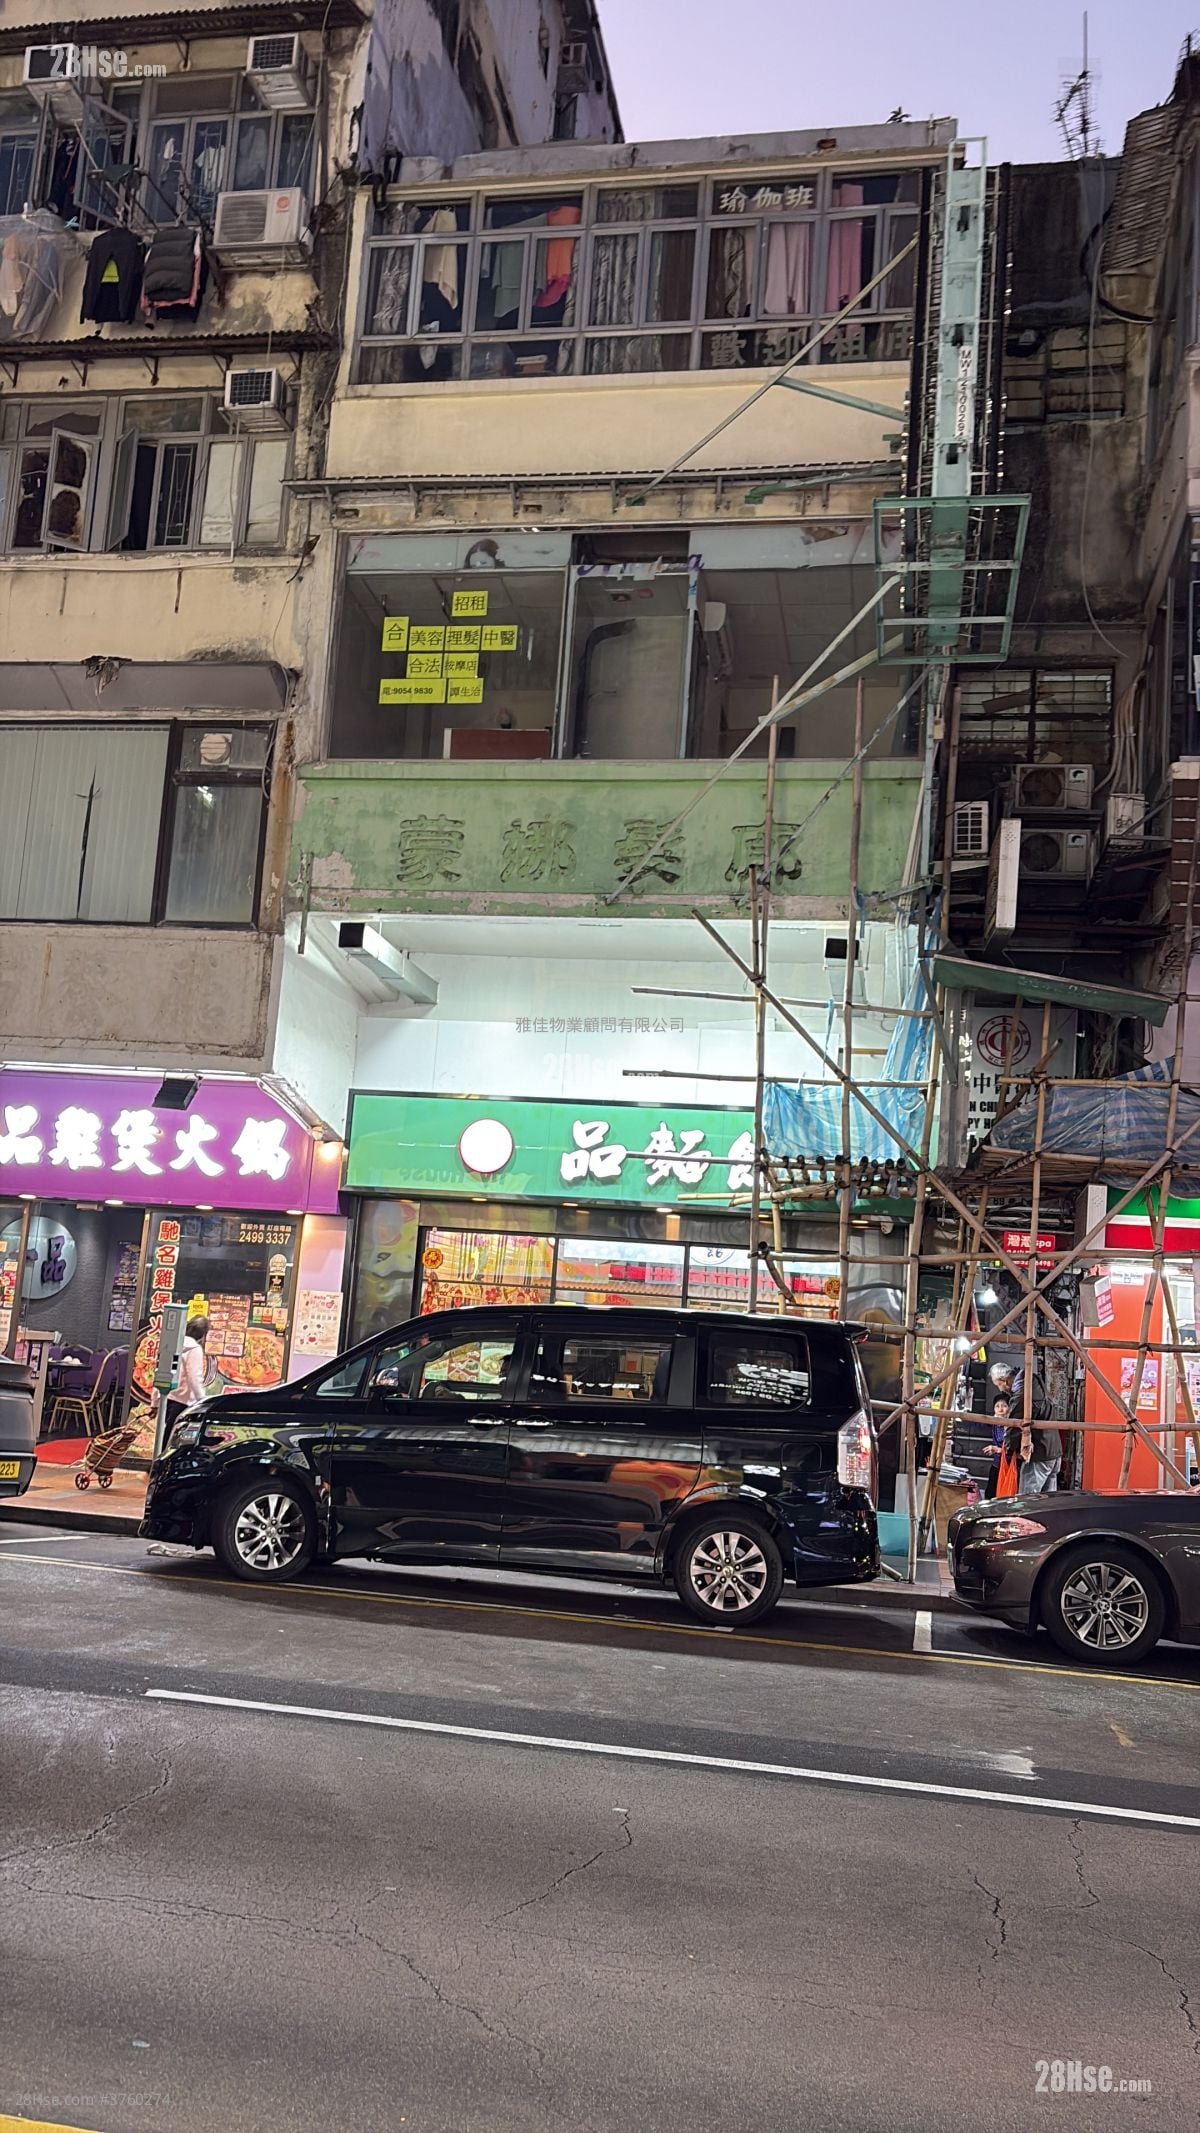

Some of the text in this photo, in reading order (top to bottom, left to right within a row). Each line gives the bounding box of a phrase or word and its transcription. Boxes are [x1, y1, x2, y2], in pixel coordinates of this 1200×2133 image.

[719, 185, 814, 213] 瑜伽班
[454, 596, 485, 611] 招租
[386, 622, 514, 646] 合 美容 理髮 中醫
[409, 659, 441, 674] 合法
[239, 1231, 291, 1245] 2499 3337
